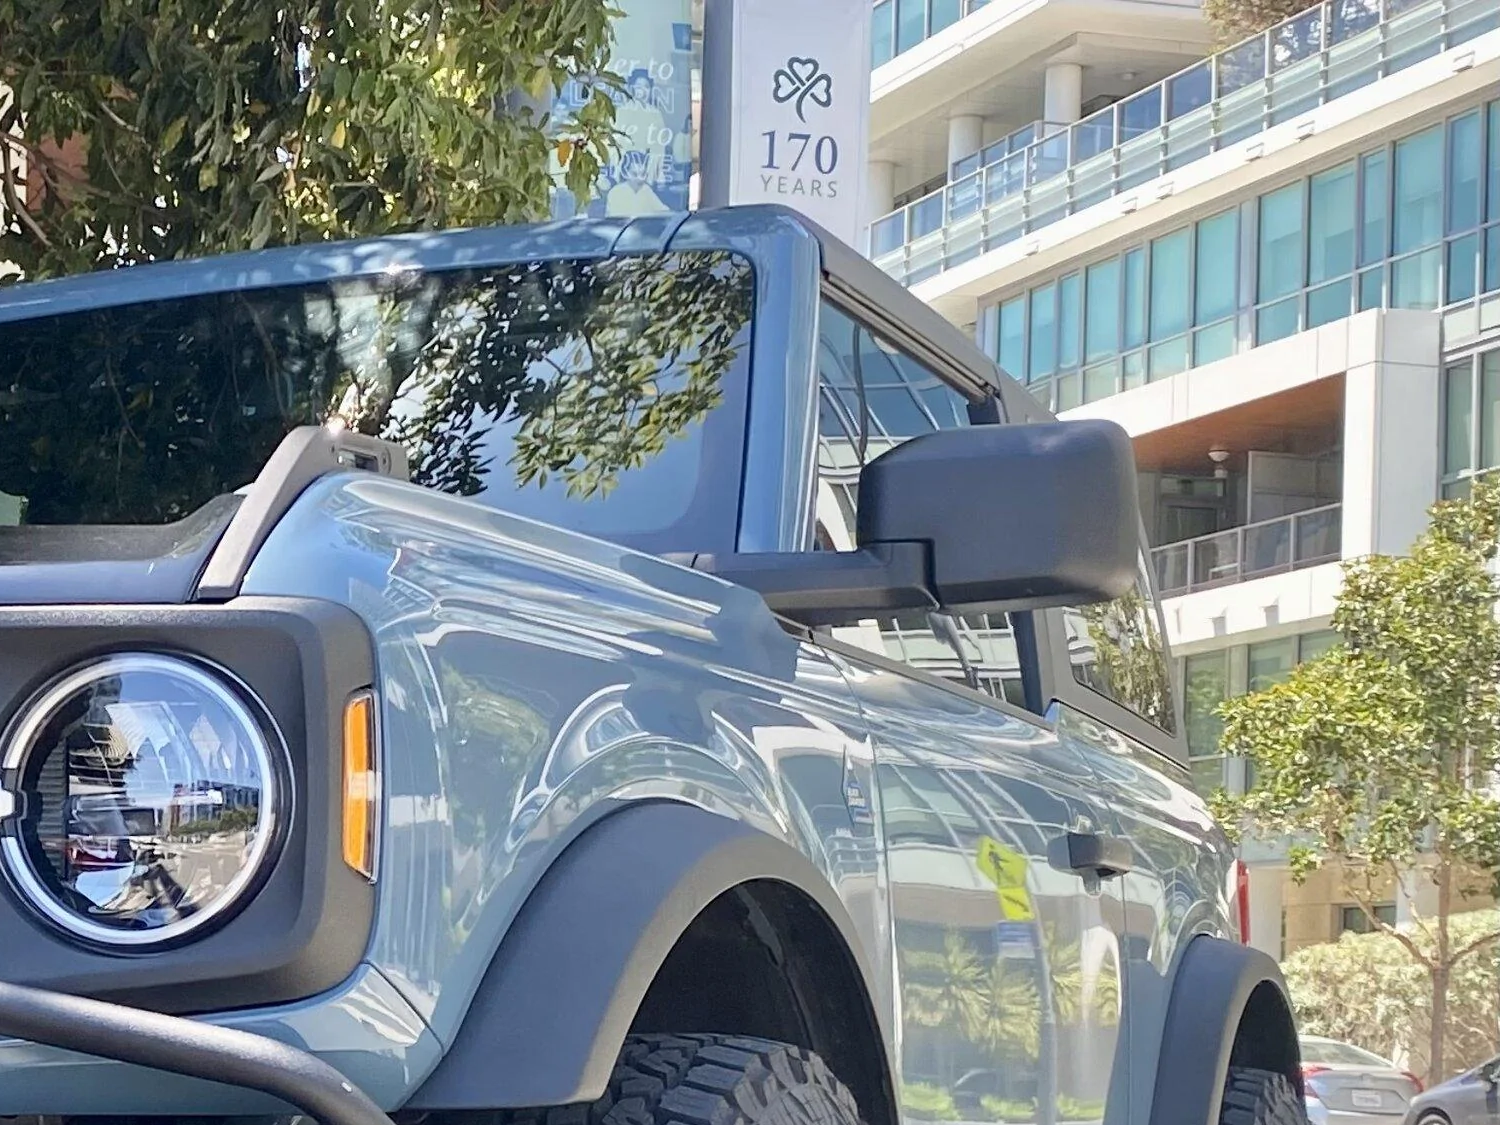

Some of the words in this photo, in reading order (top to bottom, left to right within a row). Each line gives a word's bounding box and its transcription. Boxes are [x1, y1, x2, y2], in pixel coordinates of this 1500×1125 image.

[649, 57, 674, 80] to
[647, 122, 673, 145] to
[760, 130, 838, 175] 170
[760, 174, 838, 198] YEARS
